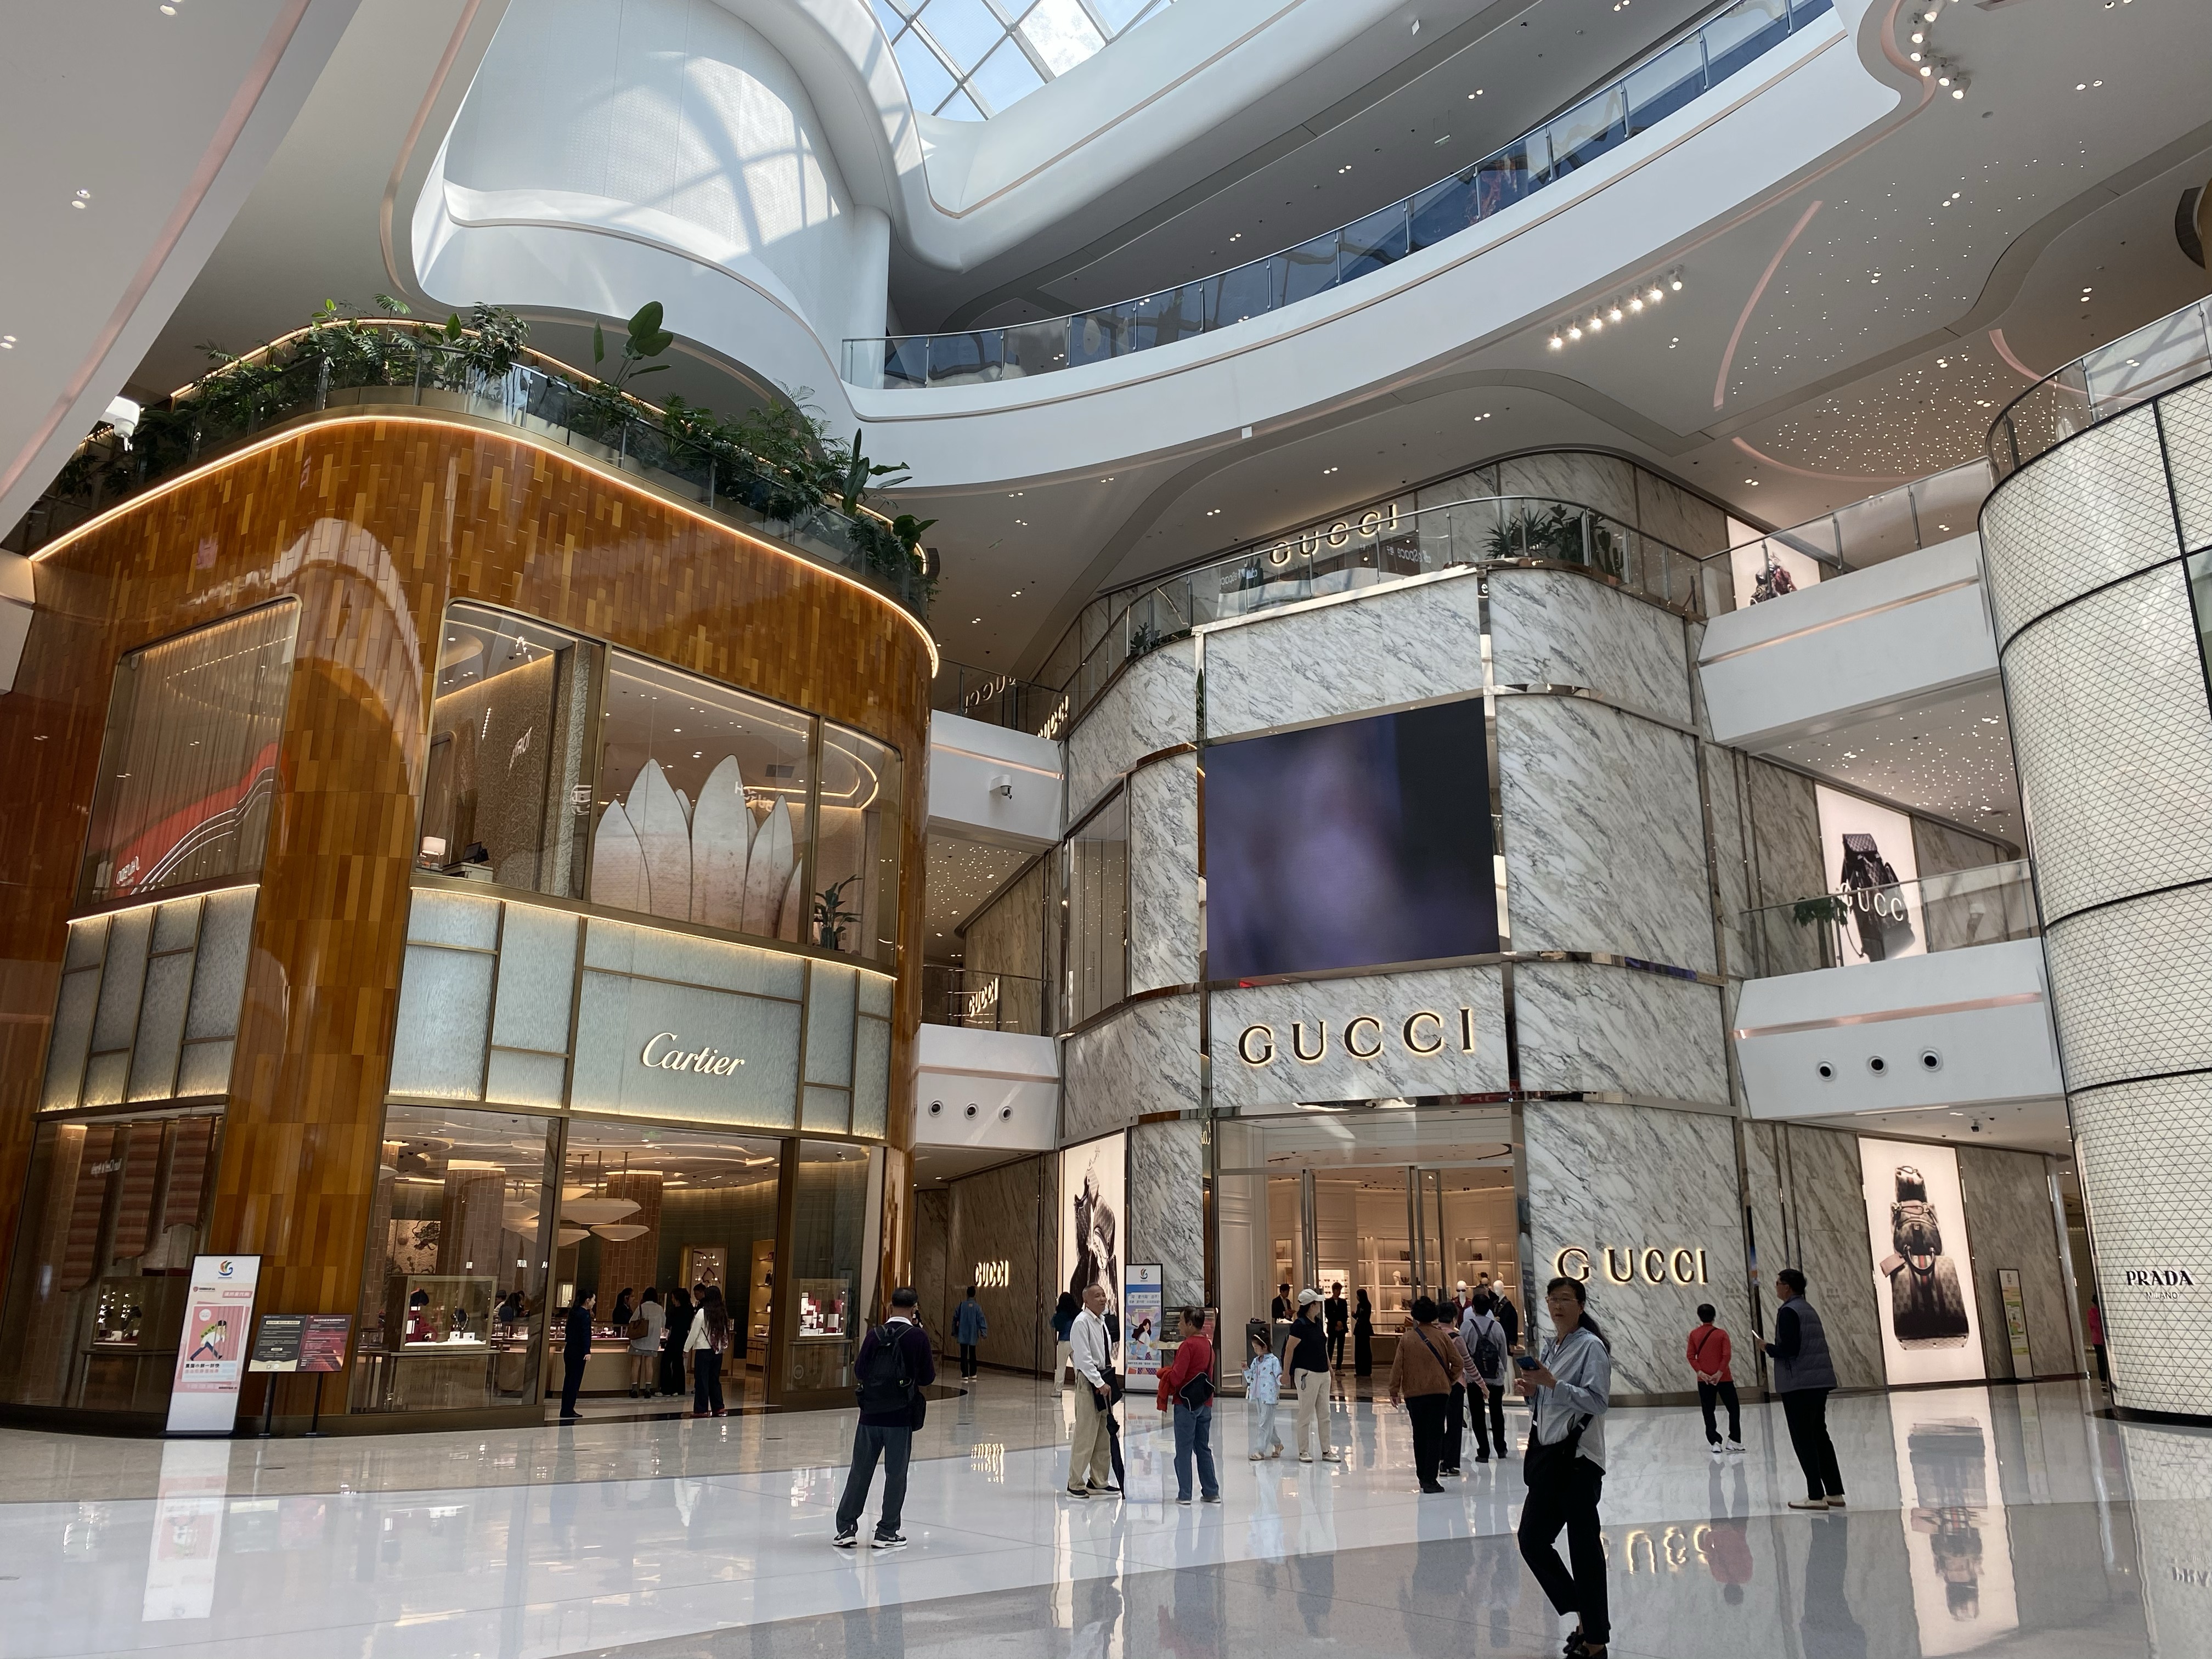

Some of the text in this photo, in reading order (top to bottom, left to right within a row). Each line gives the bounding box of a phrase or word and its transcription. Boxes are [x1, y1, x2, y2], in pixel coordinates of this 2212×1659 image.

[1268, 503, 1398, 567] GUCCI
[967, 977, 998, 1018] GUCCI
[641, 1031, 746, 1076] Cartier
[1238, 1007, 1474, 1065] GUCCI
[974, 1259, 1009, 1288] GUCCI
[1556, 1246, 1709, 1284] GUCCI
[2125, 1270, 2194, 1286] PRADA
[2146, 1291, 2179, 1300] MILANO
